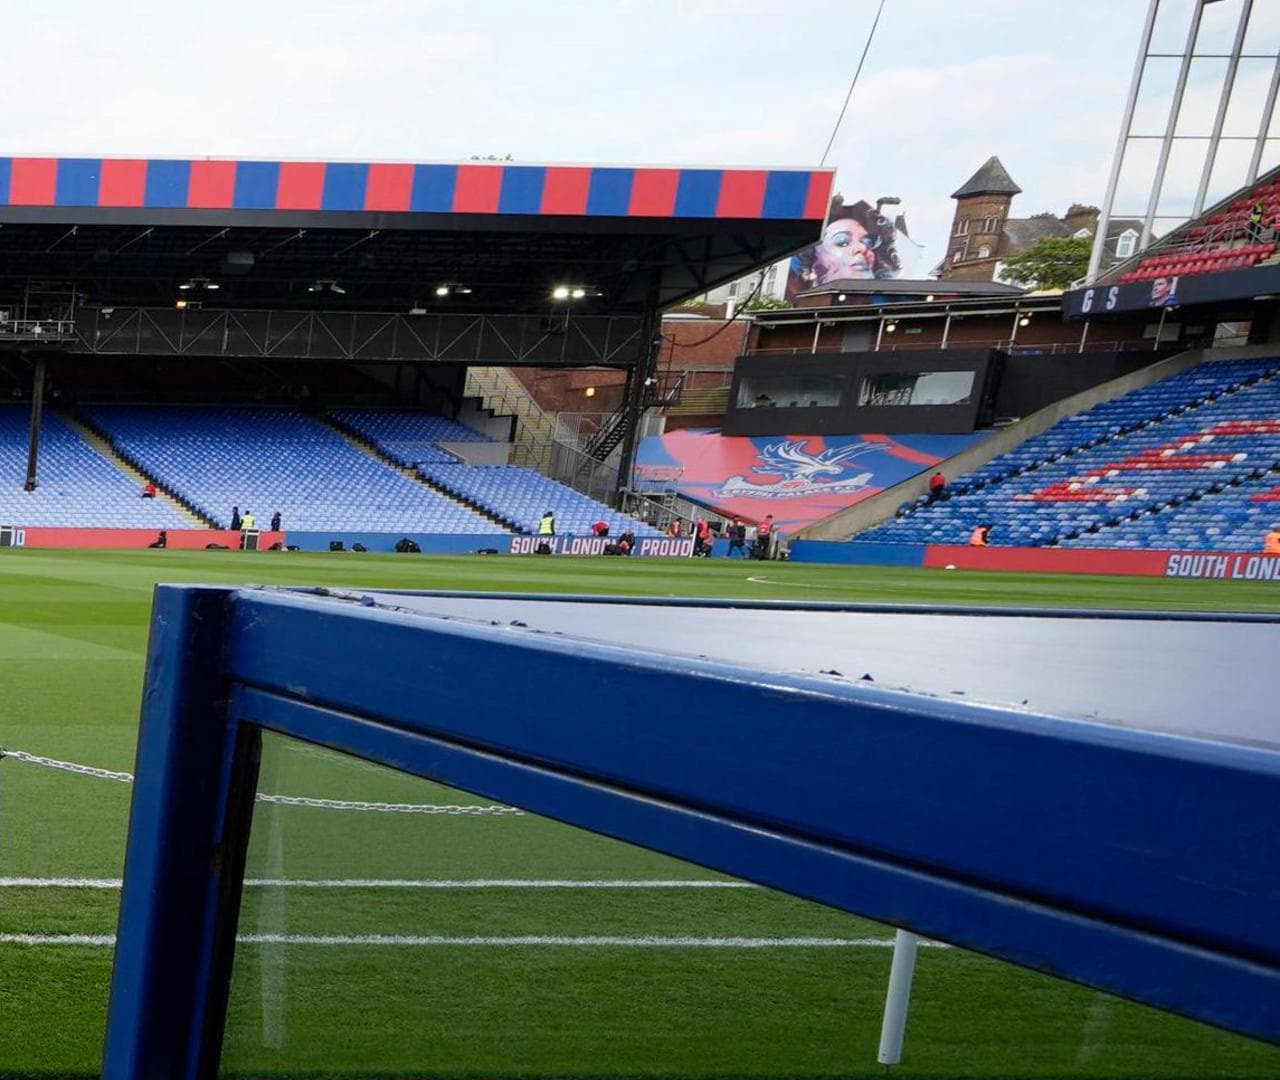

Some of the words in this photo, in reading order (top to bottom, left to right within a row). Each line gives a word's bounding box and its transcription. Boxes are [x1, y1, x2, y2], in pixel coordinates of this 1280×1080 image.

[1106, 286, 1120, 310] S
[641, 539, 691, 557] PROUD
[1166, 554, 1229, 578] SOUTH
